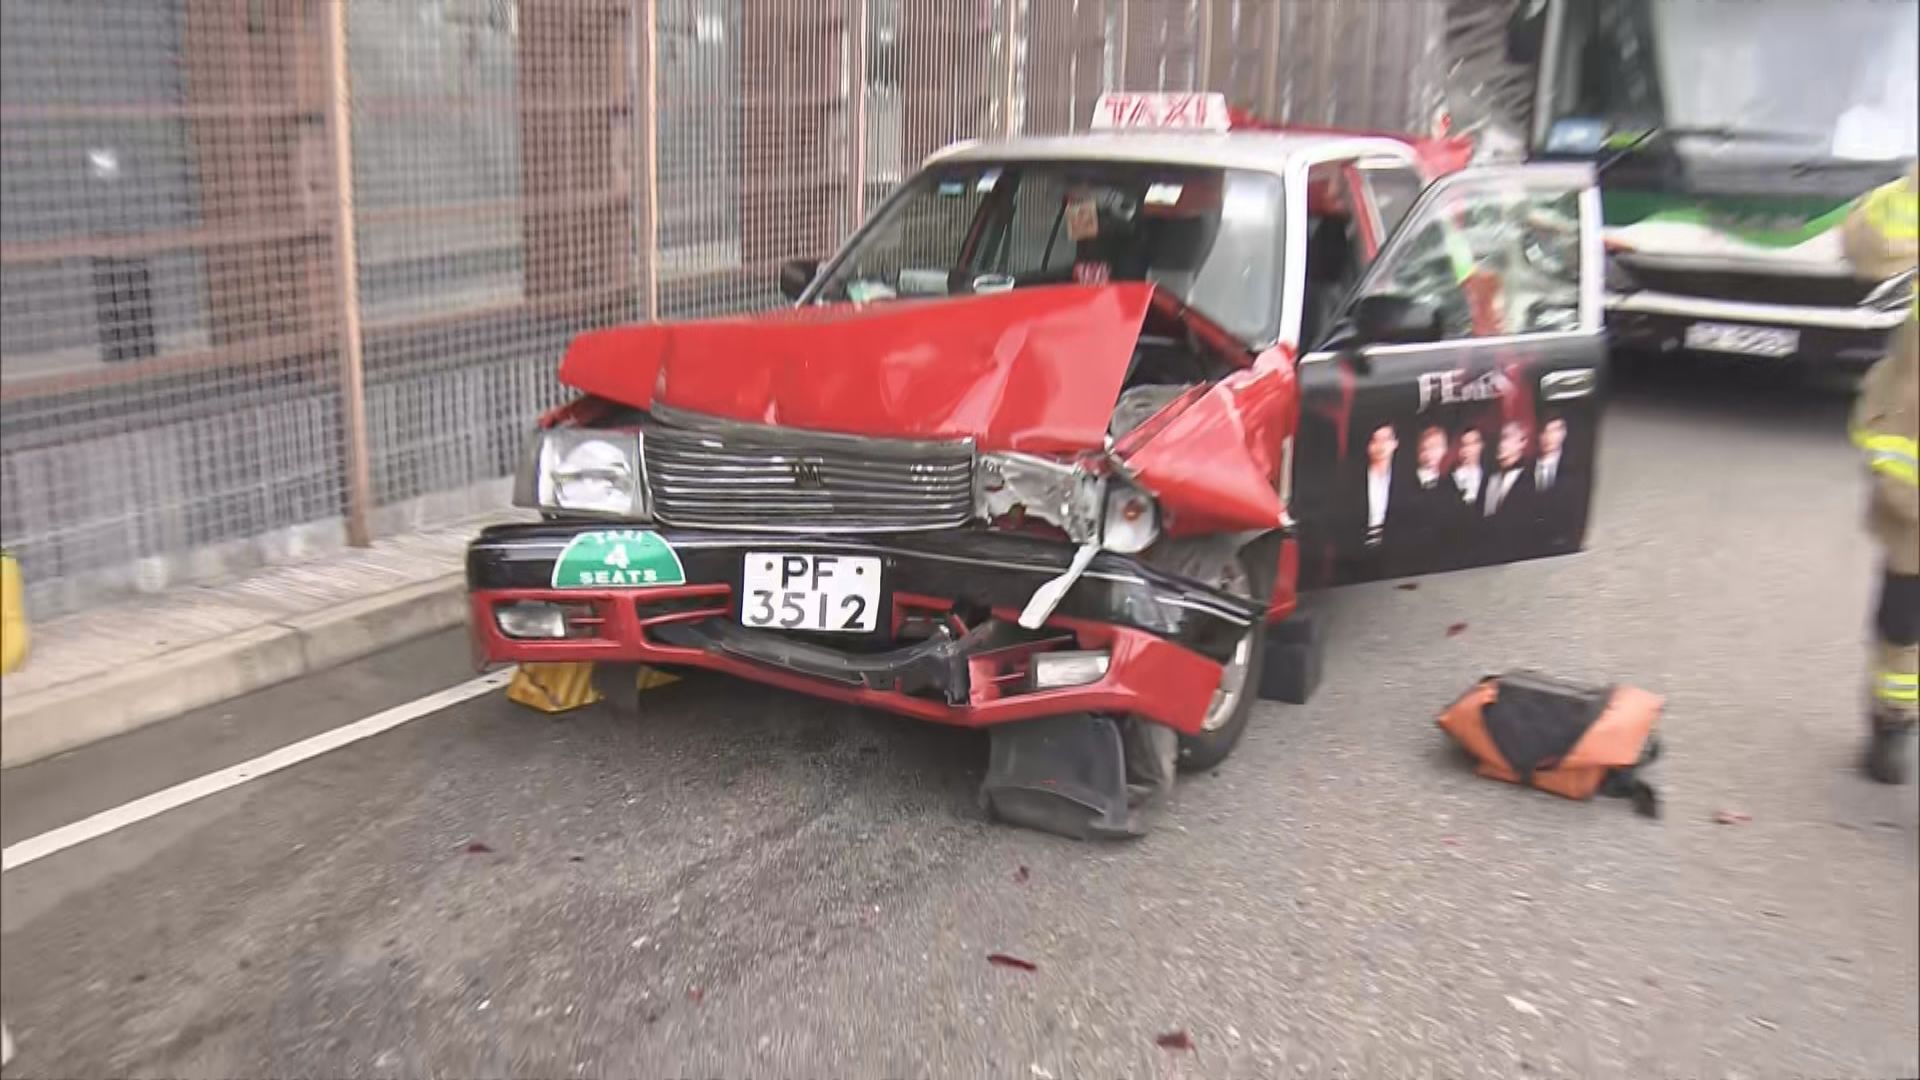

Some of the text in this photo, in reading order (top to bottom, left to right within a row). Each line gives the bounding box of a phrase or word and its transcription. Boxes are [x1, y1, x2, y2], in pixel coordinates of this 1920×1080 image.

[1105, 95, 1206, 127] TAXI
[604, 543, 630, 569] 4
[580, 570, 657, 584] SEATS
[781, 556, 838, 590] PF
[751, 590, 866, 629] 3512
